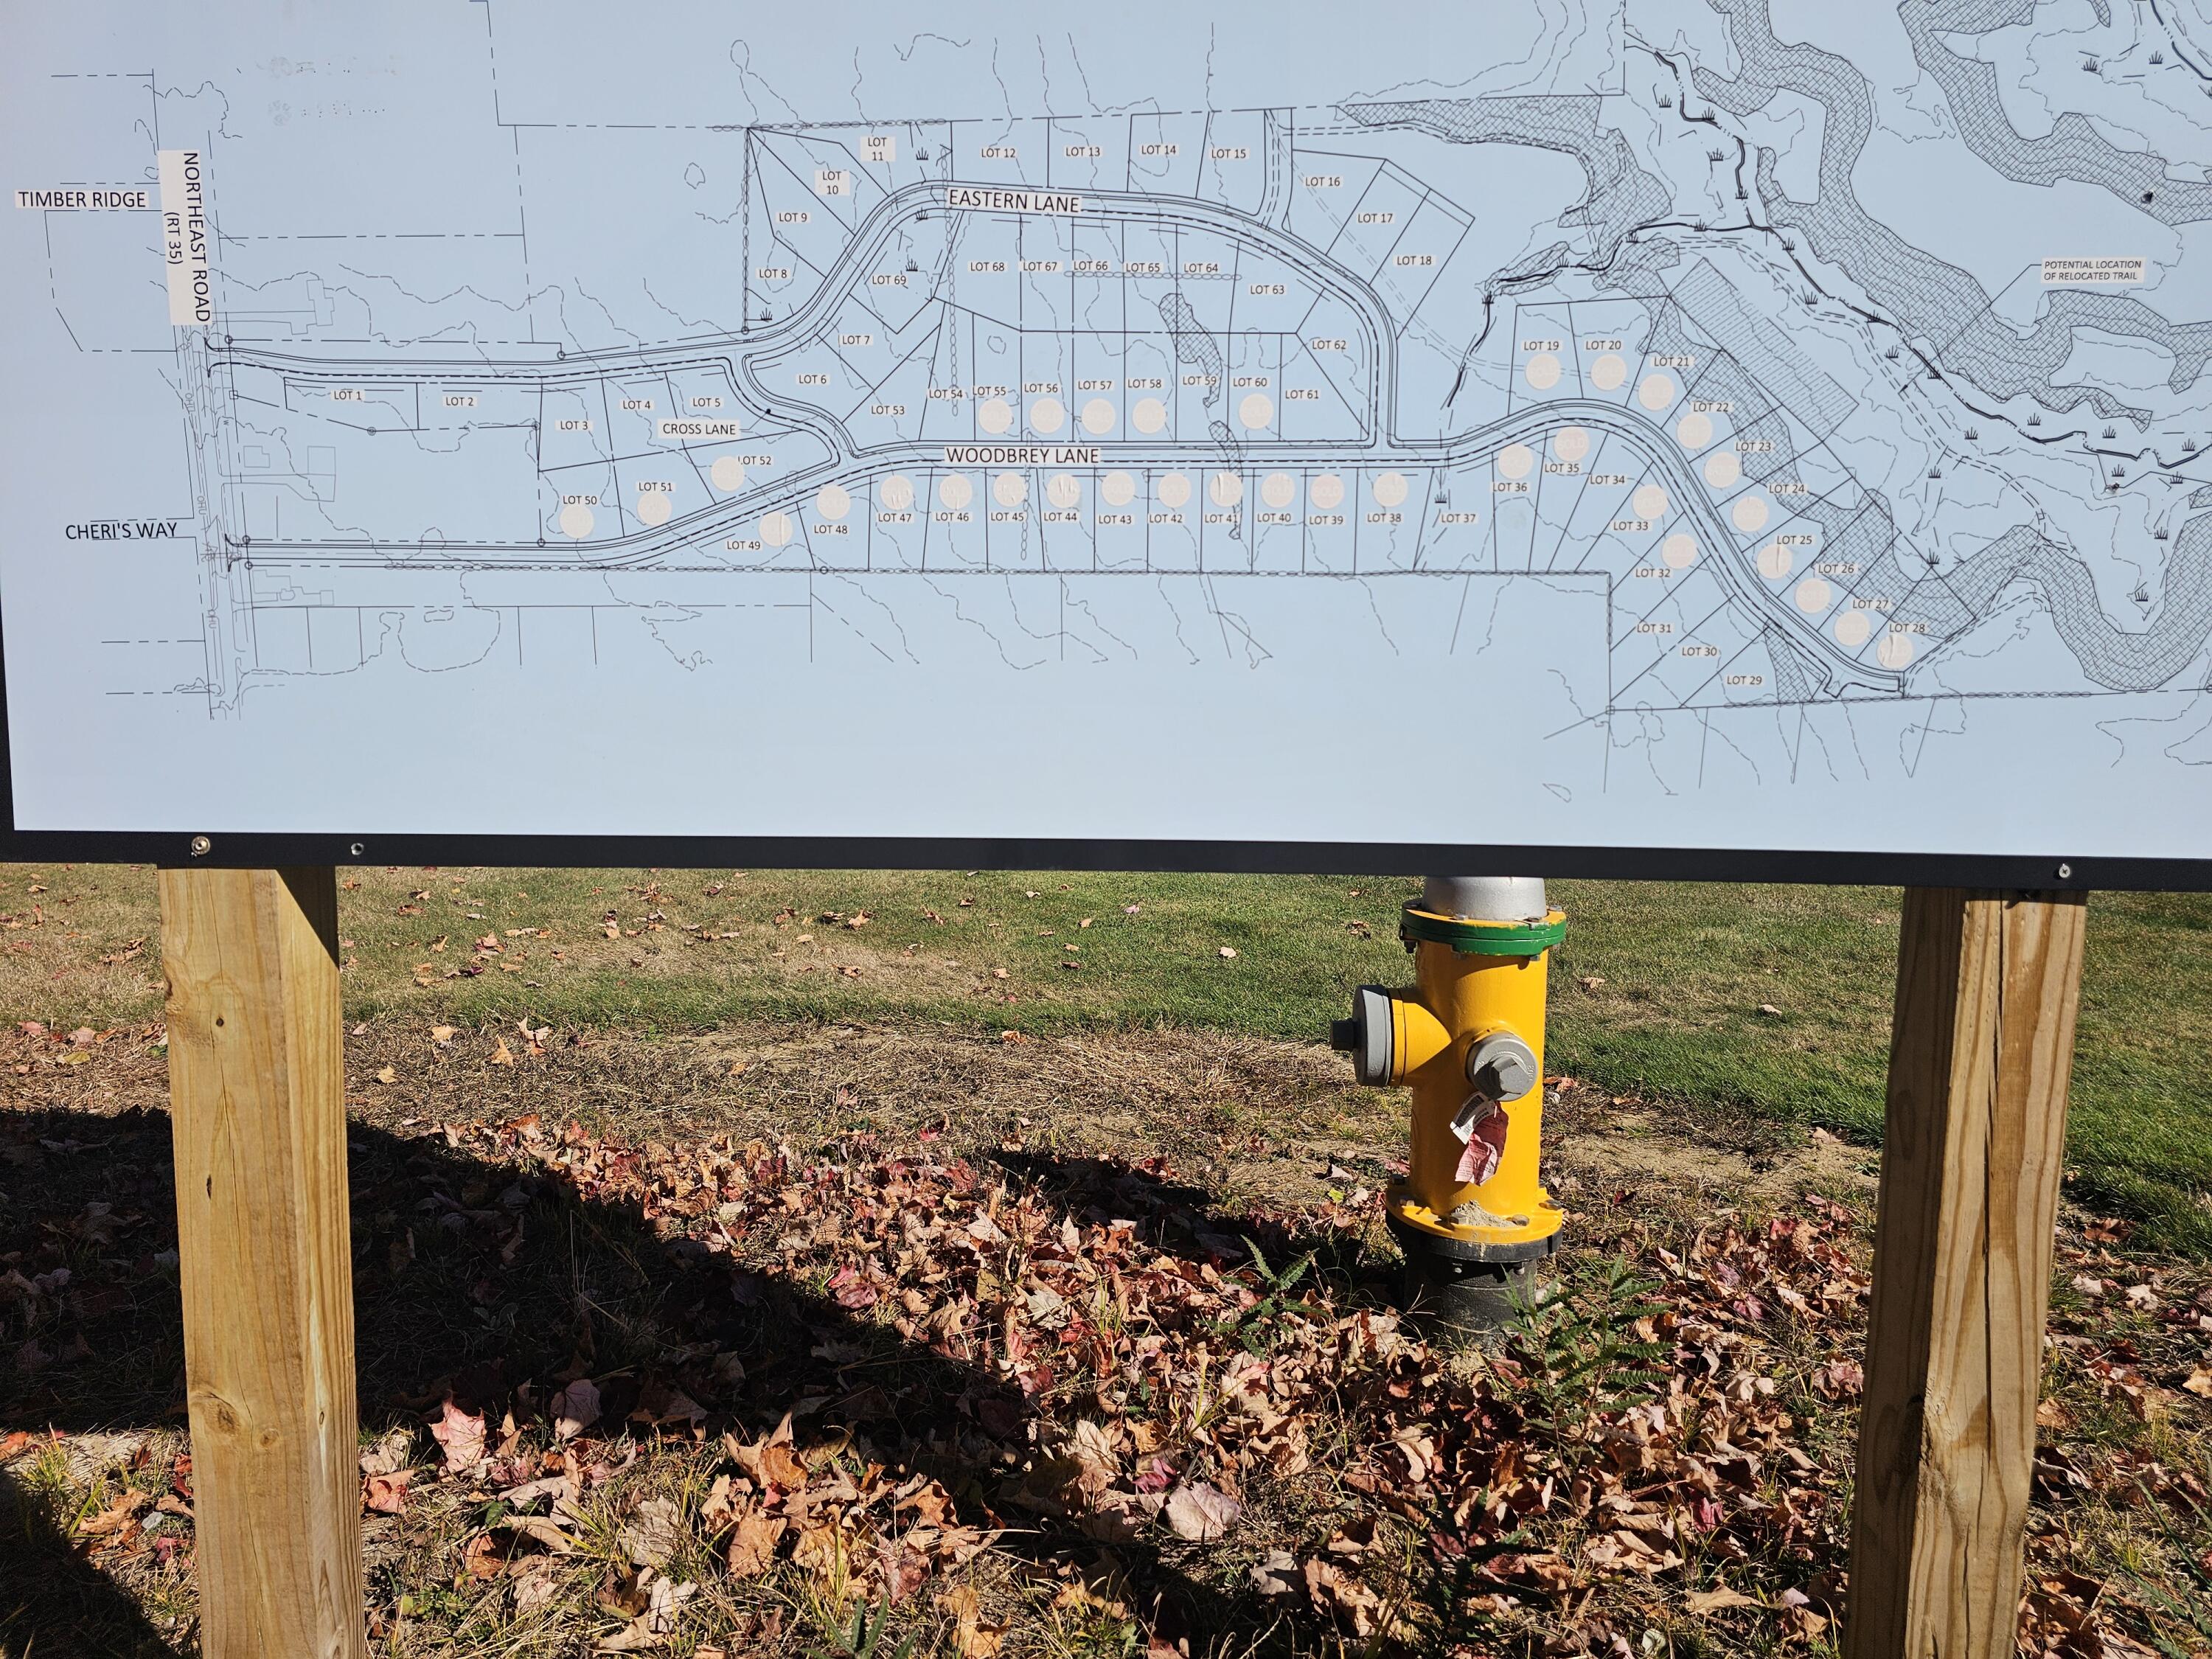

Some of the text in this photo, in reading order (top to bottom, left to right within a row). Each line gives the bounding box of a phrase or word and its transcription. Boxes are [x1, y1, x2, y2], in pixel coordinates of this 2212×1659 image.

[869, 137, 886, 147] LOT
[982, 148, 1015, 158] LOT 12
[1066, 147, 1100, 156] LOT 13
[1142, 145, 1175, 155] LOT 14
[1212, 149, 1245, 159] LOT 15
[873, 152, 883, 161] 11
[823, 171, 841, 180] LOT
[1306, 177, 1340, 187] LOT 16
[827, 185, 838, 195] 10
[18, 192, 145, 207] TIMBER RIDGE
[948, 189, 1079, 212] EASTERN LANE
[779, 213, 807, 222] LOT 9
[1358, 214, 1392, 223] LOT 17
[164, 212, 183, 264] (RT 35)
[184, 153, 210, 321] NORTHEAST ROAD
[1397, 256, 1431, 265] LOT 18
[971, 262, 1004, 271] LOT 68
[1023, 262, 1057, 271] LOT 67
[1074, 261, 1107, 270] LOT 66
[1127, 263, 1160, 273] LOT 65
[1184, 263, 1217, 272] LOT 64
[759, 269, 787, 278] LOT 8
[2059, 272, 2110, 280] RELOCATED
[872, 276, 906, 286] LOT 69
[1251, 285, 1284, 294] LOT 63
[843, 335, 869, 344] LOT 7
[1312, 341, 1346, 349] LOT 62
[1524, 341, 1559, 350] LOT 19
[1586, 341, 1621, 349] LOT 20
[1655, 356, 1688, 366] LOT 21
[799, 375, 826, 383] LOT 6
[1128, 379, 1161, 388] LOT 58
[1234, 378, 1267, 386] LOT 60
[1025, 383, 1057, 393] LOT 56
[1079, 380, 1111, 389] LOT 57
[335, 392, 361, 400] LOT 1
[973, 386, 1006, 397] LOT 55
[1286, 390, 1318, 399] LOT 61
[446, 397, 473, 406] LOT 2
[623, 400, 641, 409] LOT
[693, 398, 720, 407] LOT 5
[872, 406, 904, 414] LOT 53
[1694, 402, 1728, 413] LOT 22
[561, 421, 588, 430] LOT 3
[664, 424, 735, 434] CROSS LANE
[1736, 442, 1770, 451] LOT 23
[947, 448, 1098, 463] WOODBREY LANE
[1545, 464, 1579, 473] LOT 35
[1589, 475, 1624, 484] LOT 34
[639, 482, 672, 491] LOT 51
[1493, 483, 1527, 493] LOT 36
[1770, 484, 1804, 493] LOT 24
[563, 495, 597, 504] LOT 50
[879, 513, 911, 522] LOT 47
[936, 512, 968, 521] LOT 46
[991, 512, 1023, 521] LOT 45
[1044, 512, 1062, 521] LOT
[1099, 515, 1131, 524] LOT 43
[1150, 514, 1182, 523] LOT 42
[1258, 513, 1291, 522] LOT 40
[1310, 516, 1343, 524] LOT 39
[1368, 513, 1401, 523] LOT 38
[1441, 514, 1475, 523] LOT 37
[815, 525, 847, 534] LOT 48
[1614, 521, 1648, 530] LOT 33
[66, 522, 177, 539] CHERI'S WAY
[1777, 535, 1812, 544] LOT 25
[728, 541, 760, 549] LOT 49
[1636, 568, 1670, 577] LOT 32
[1819, 563, 1854, 574] LOT 26
[1853, 599, 1888, 610] LOT 27
[1638, 623, 1671, 633] LOT 31
[1890, 624, 1927, 633] LOT 28
[1683, 647, 1717, 656] LOT 30
[1728, 676, 1761, 684] LOT 29
